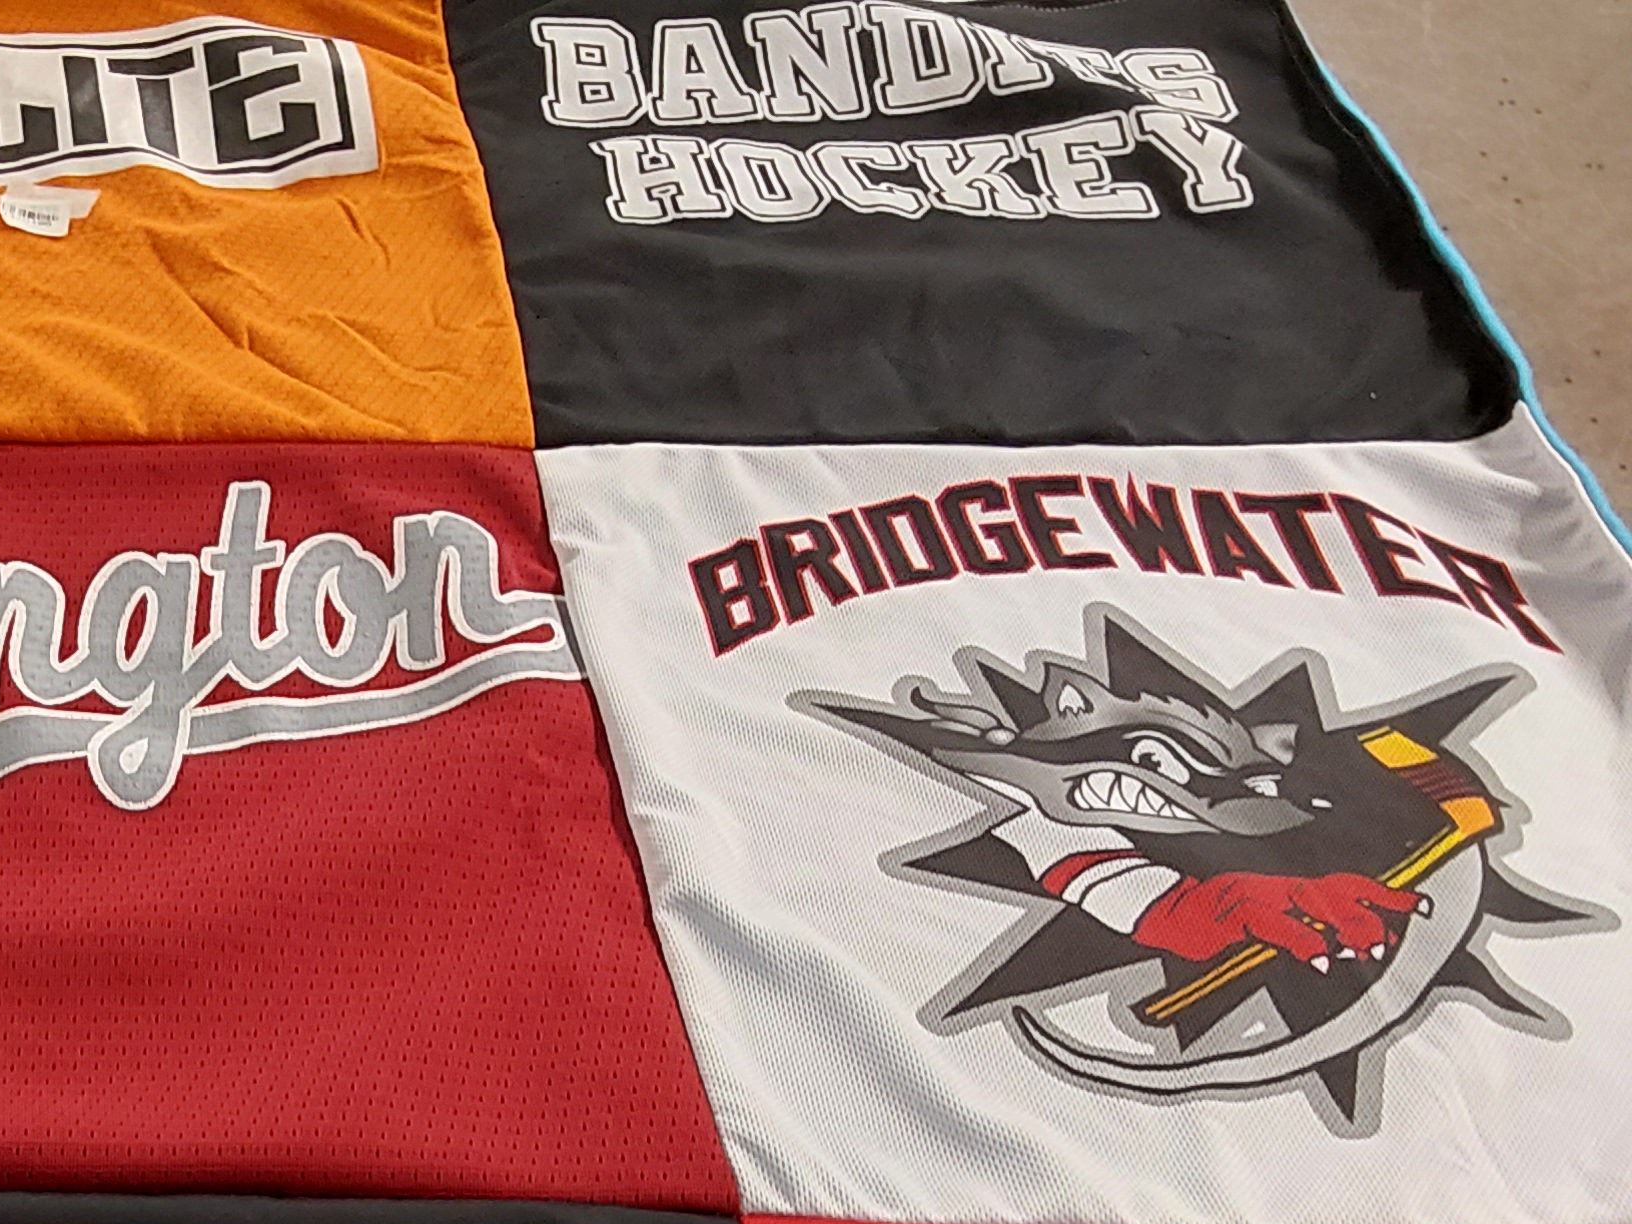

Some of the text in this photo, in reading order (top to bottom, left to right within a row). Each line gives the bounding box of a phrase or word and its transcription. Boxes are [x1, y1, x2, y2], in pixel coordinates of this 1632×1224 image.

[531, 1, 1239, 127] BANDITS
[589, 105, 1254, 224] HOCKEY
[688, 471, 1565, 657] BRIDGEWATER
